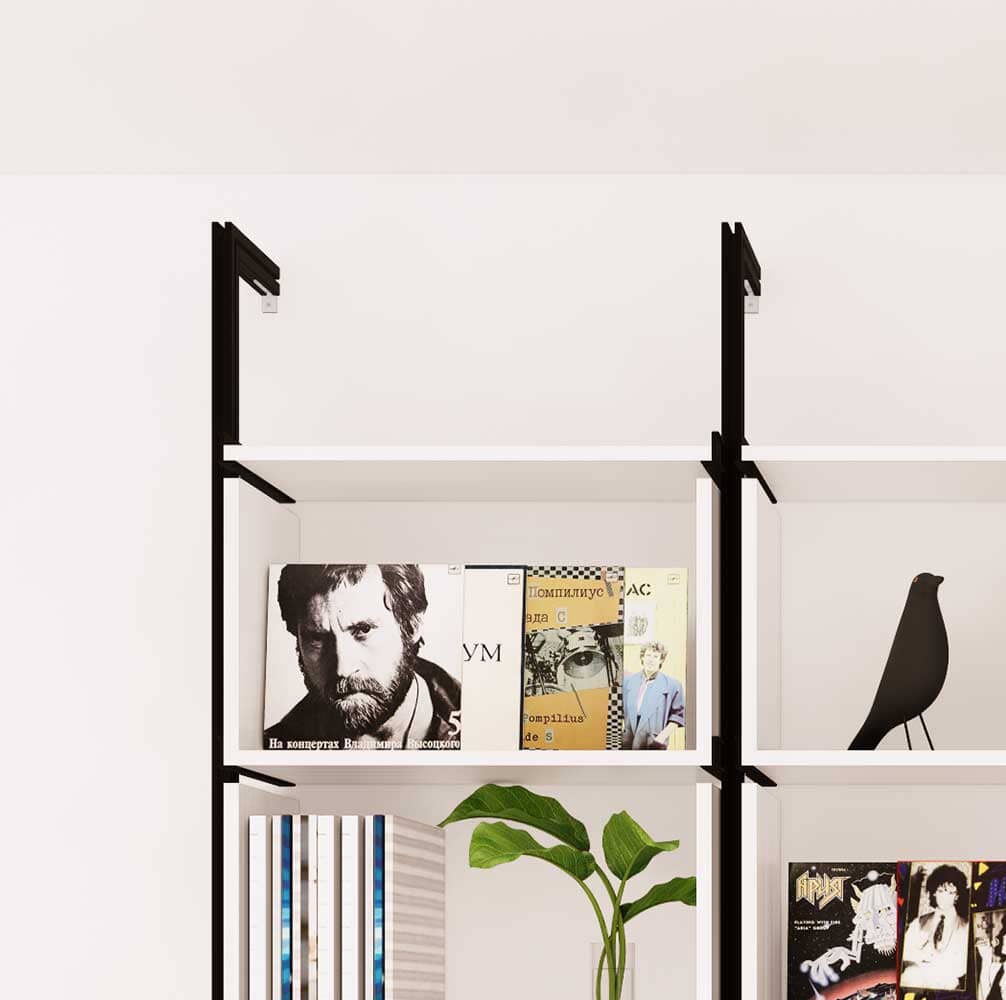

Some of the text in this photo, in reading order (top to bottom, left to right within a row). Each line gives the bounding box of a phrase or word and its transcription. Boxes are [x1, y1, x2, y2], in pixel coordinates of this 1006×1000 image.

[529, 586, 604, 600] Помпилиус
[462, 643, 502, 662] УМ
[448, 710, 462, 736] 5
[269, 738, 461, 750] На концертах Владимира Высоцкого
